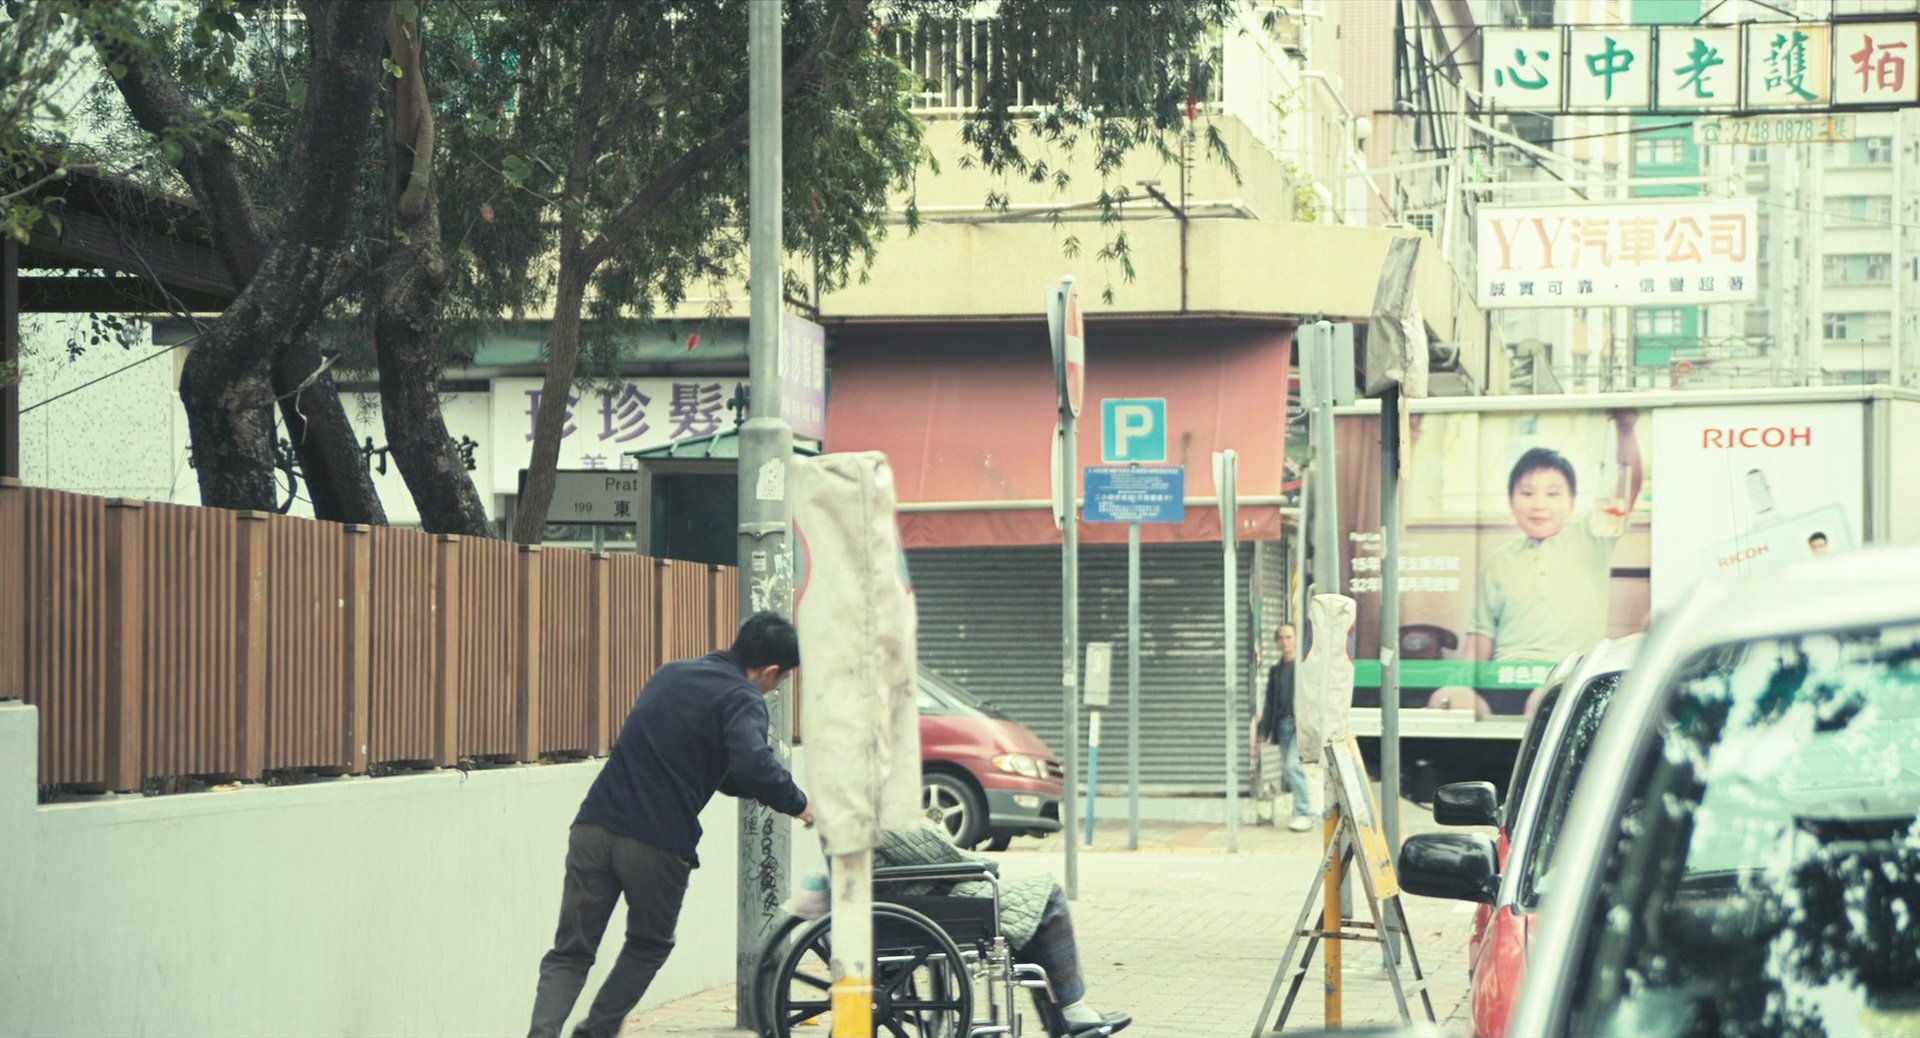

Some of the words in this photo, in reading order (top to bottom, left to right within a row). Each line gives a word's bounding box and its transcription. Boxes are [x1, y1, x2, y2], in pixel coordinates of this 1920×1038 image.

[1776, 120, 1812, 141] 0878
[1115, 405, 1153, 456] P
[1703, 427, 1811, 448] RICOH
[605, 477, 637, 490] Prat
[574, 502, 592, 512] 199
[614, 500, 630, 517] 東
[1718, 545, 1769, 568] RICOH
